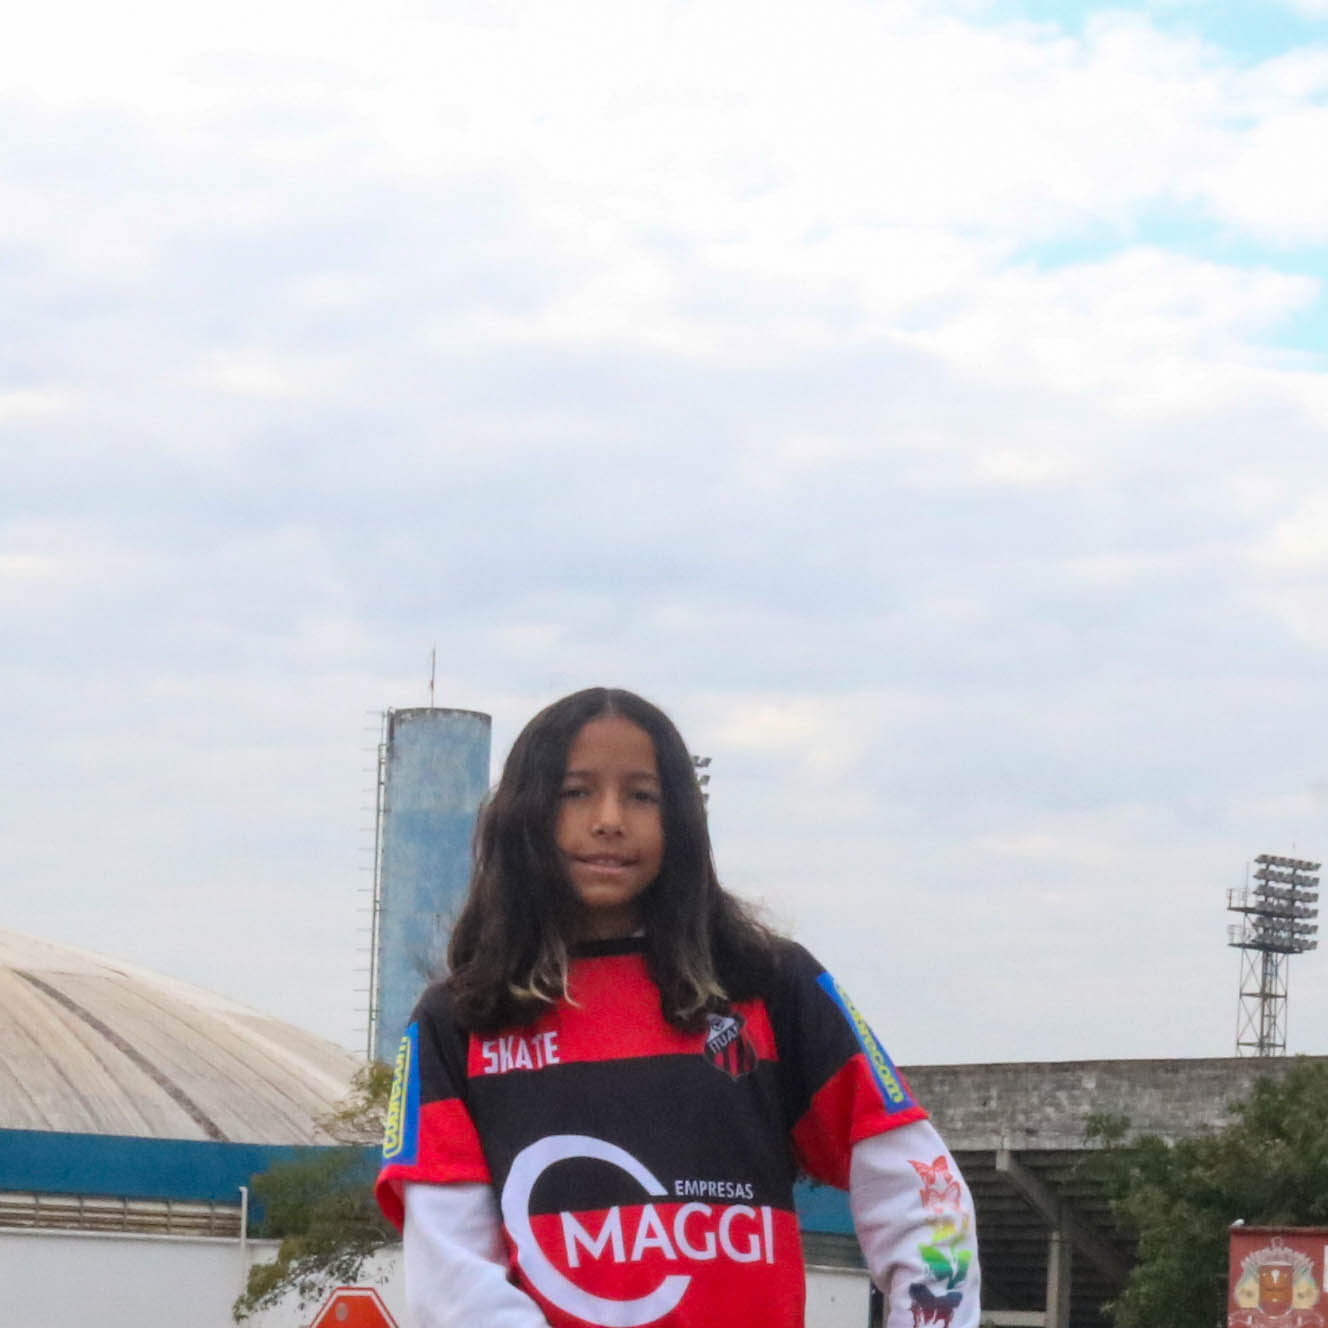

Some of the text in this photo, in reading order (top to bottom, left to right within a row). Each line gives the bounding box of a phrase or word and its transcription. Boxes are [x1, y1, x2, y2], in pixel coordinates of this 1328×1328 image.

[482, 1031, 560, 1075] SKATE
[674, 1180, 754, 1200] EMPRESAS
[560, 1202, 774, 1268] MAGGI
